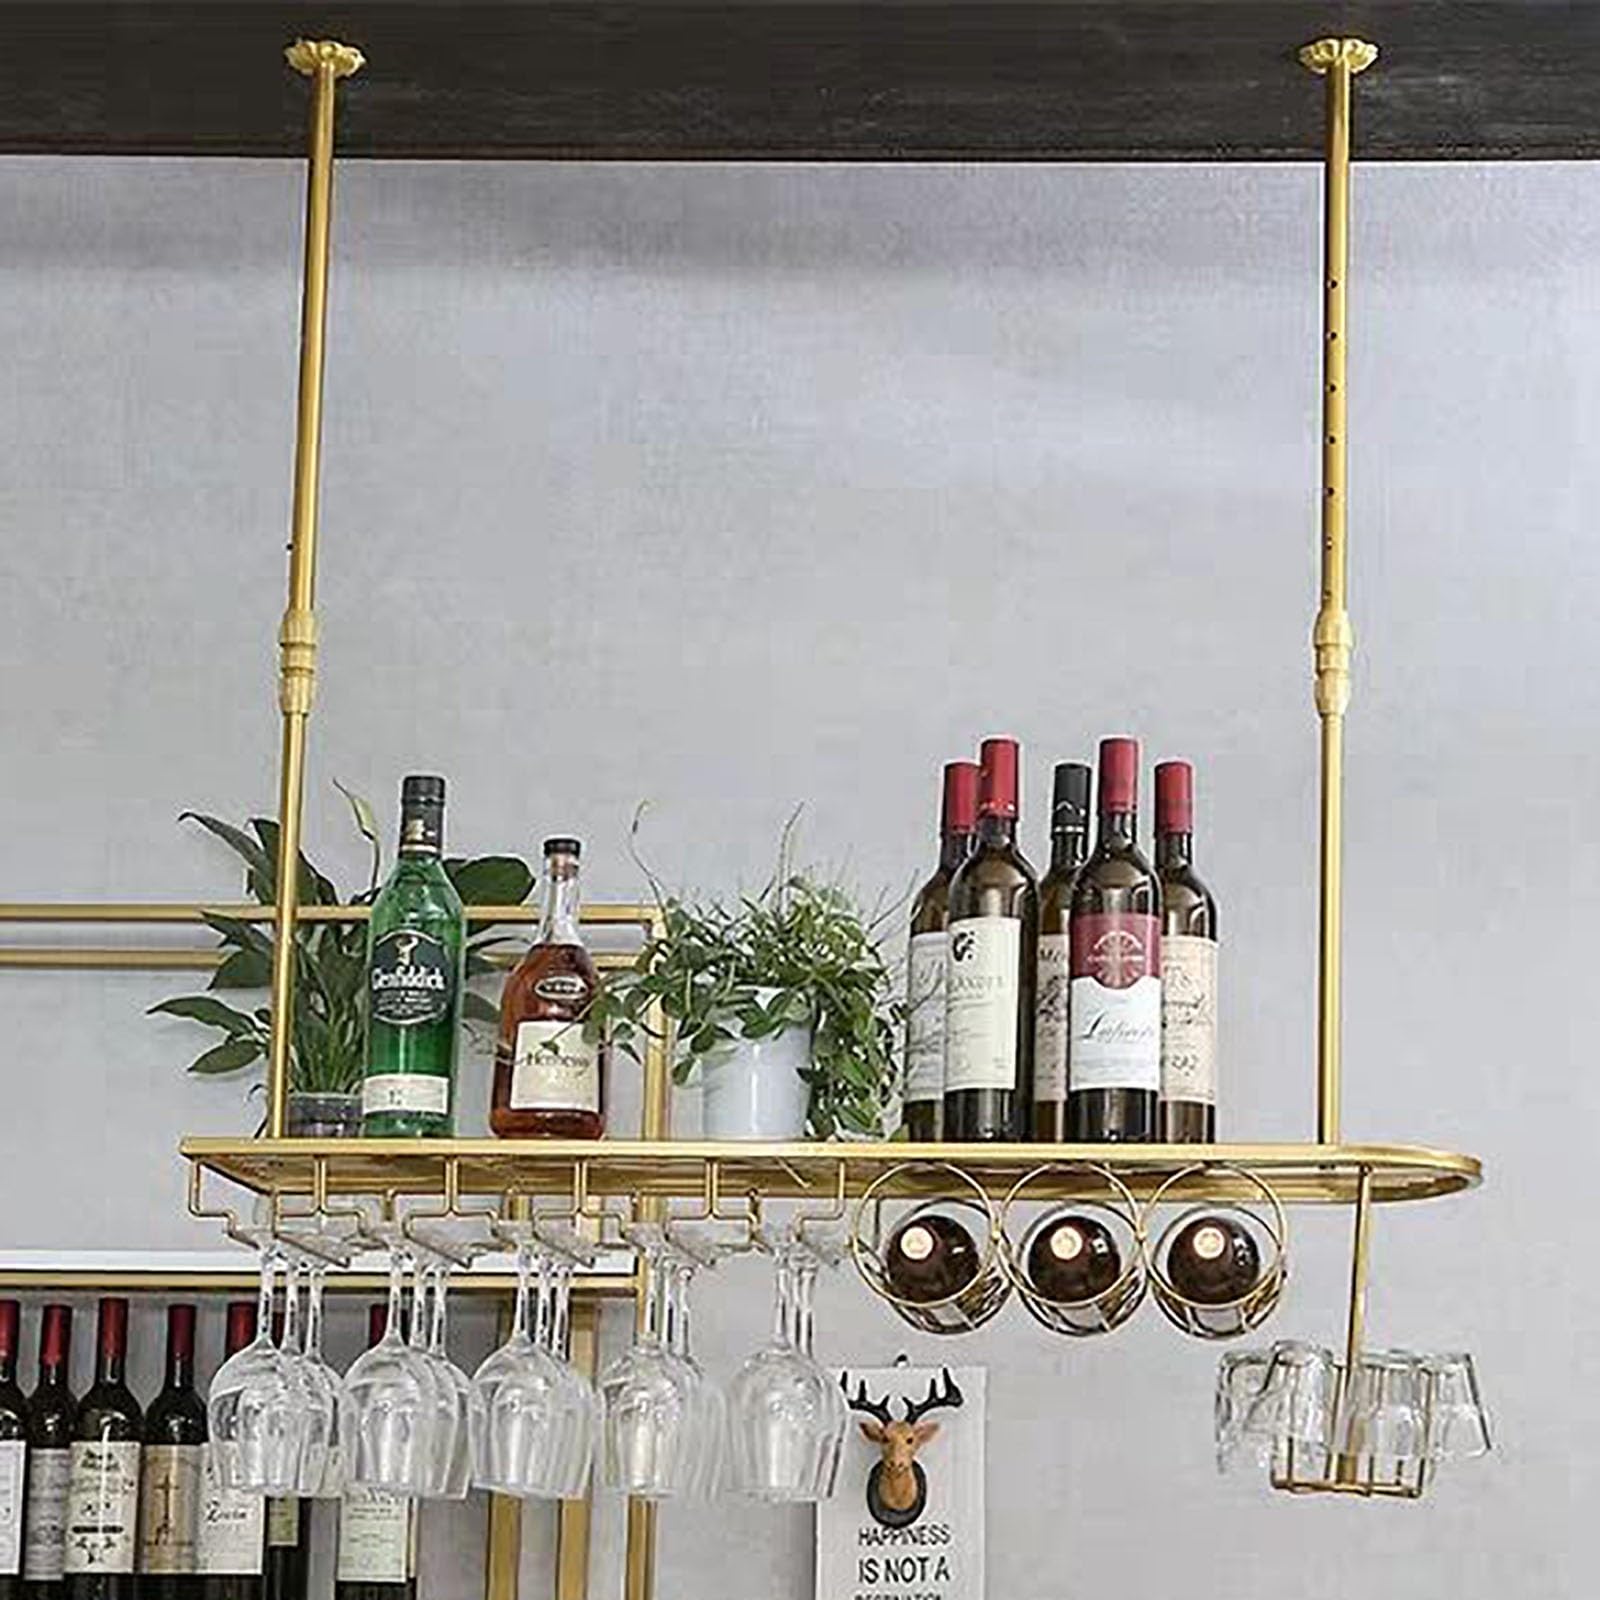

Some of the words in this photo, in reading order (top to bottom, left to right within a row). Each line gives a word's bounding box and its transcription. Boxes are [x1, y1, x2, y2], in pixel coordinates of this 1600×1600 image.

[858, 1524, 951, 1546] HAPPINESS
[859, 1558, 879, 1584] IS
[884, 1556, 929, 1584] NOT
[934, 1556, 950, 1581] A
